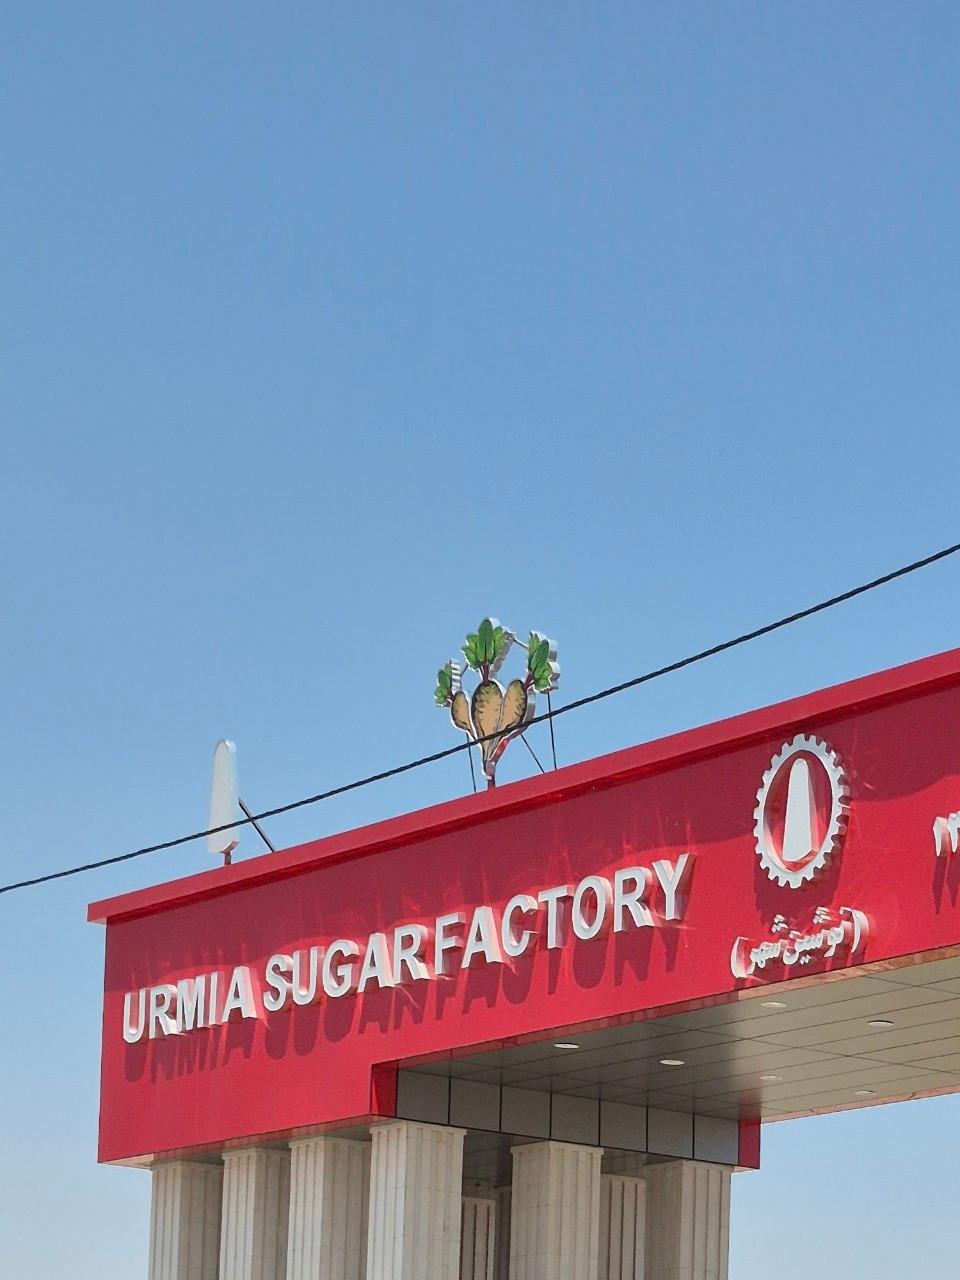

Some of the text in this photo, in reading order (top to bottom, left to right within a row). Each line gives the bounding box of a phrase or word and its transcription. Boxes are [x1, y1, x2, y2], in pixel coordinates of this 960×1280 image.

[122, 852, 697, 1044] URMIA SUGAR FACTORY
